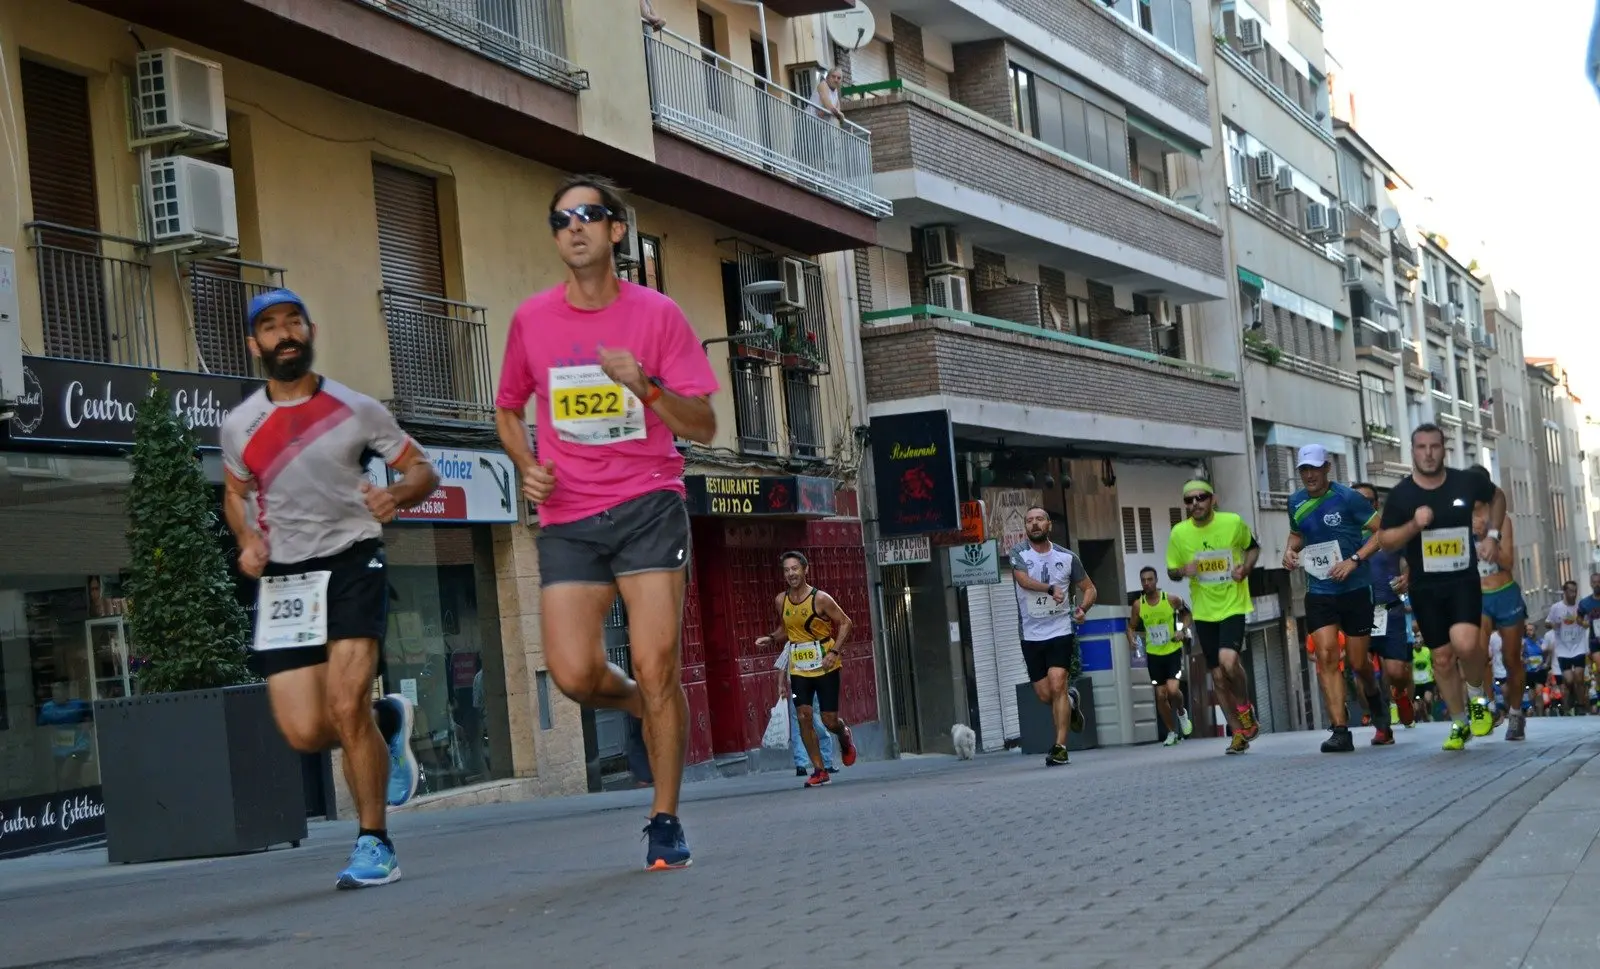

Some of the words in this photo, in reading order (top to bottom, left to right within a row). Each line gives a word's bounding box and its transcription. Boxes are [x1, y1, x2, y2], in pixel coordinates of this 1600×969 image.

[65, 380, 137, 429] Centro
[559, 392, 619, 416] 1522
[889, 442, 937, 460] Restaurante
[705, 477, 760, 495] RESTAURANTE
[878, 551, 889, 563] DE
[893, 547, 929, 561] CALZADO
[1426, 543, 1458, 556] 1471
[271, 598, 304, 620] 239
[1036, 597, 1048, 605] 47
[42, 802, 57, 827] de
[61, 795, 105, 830] Estética
